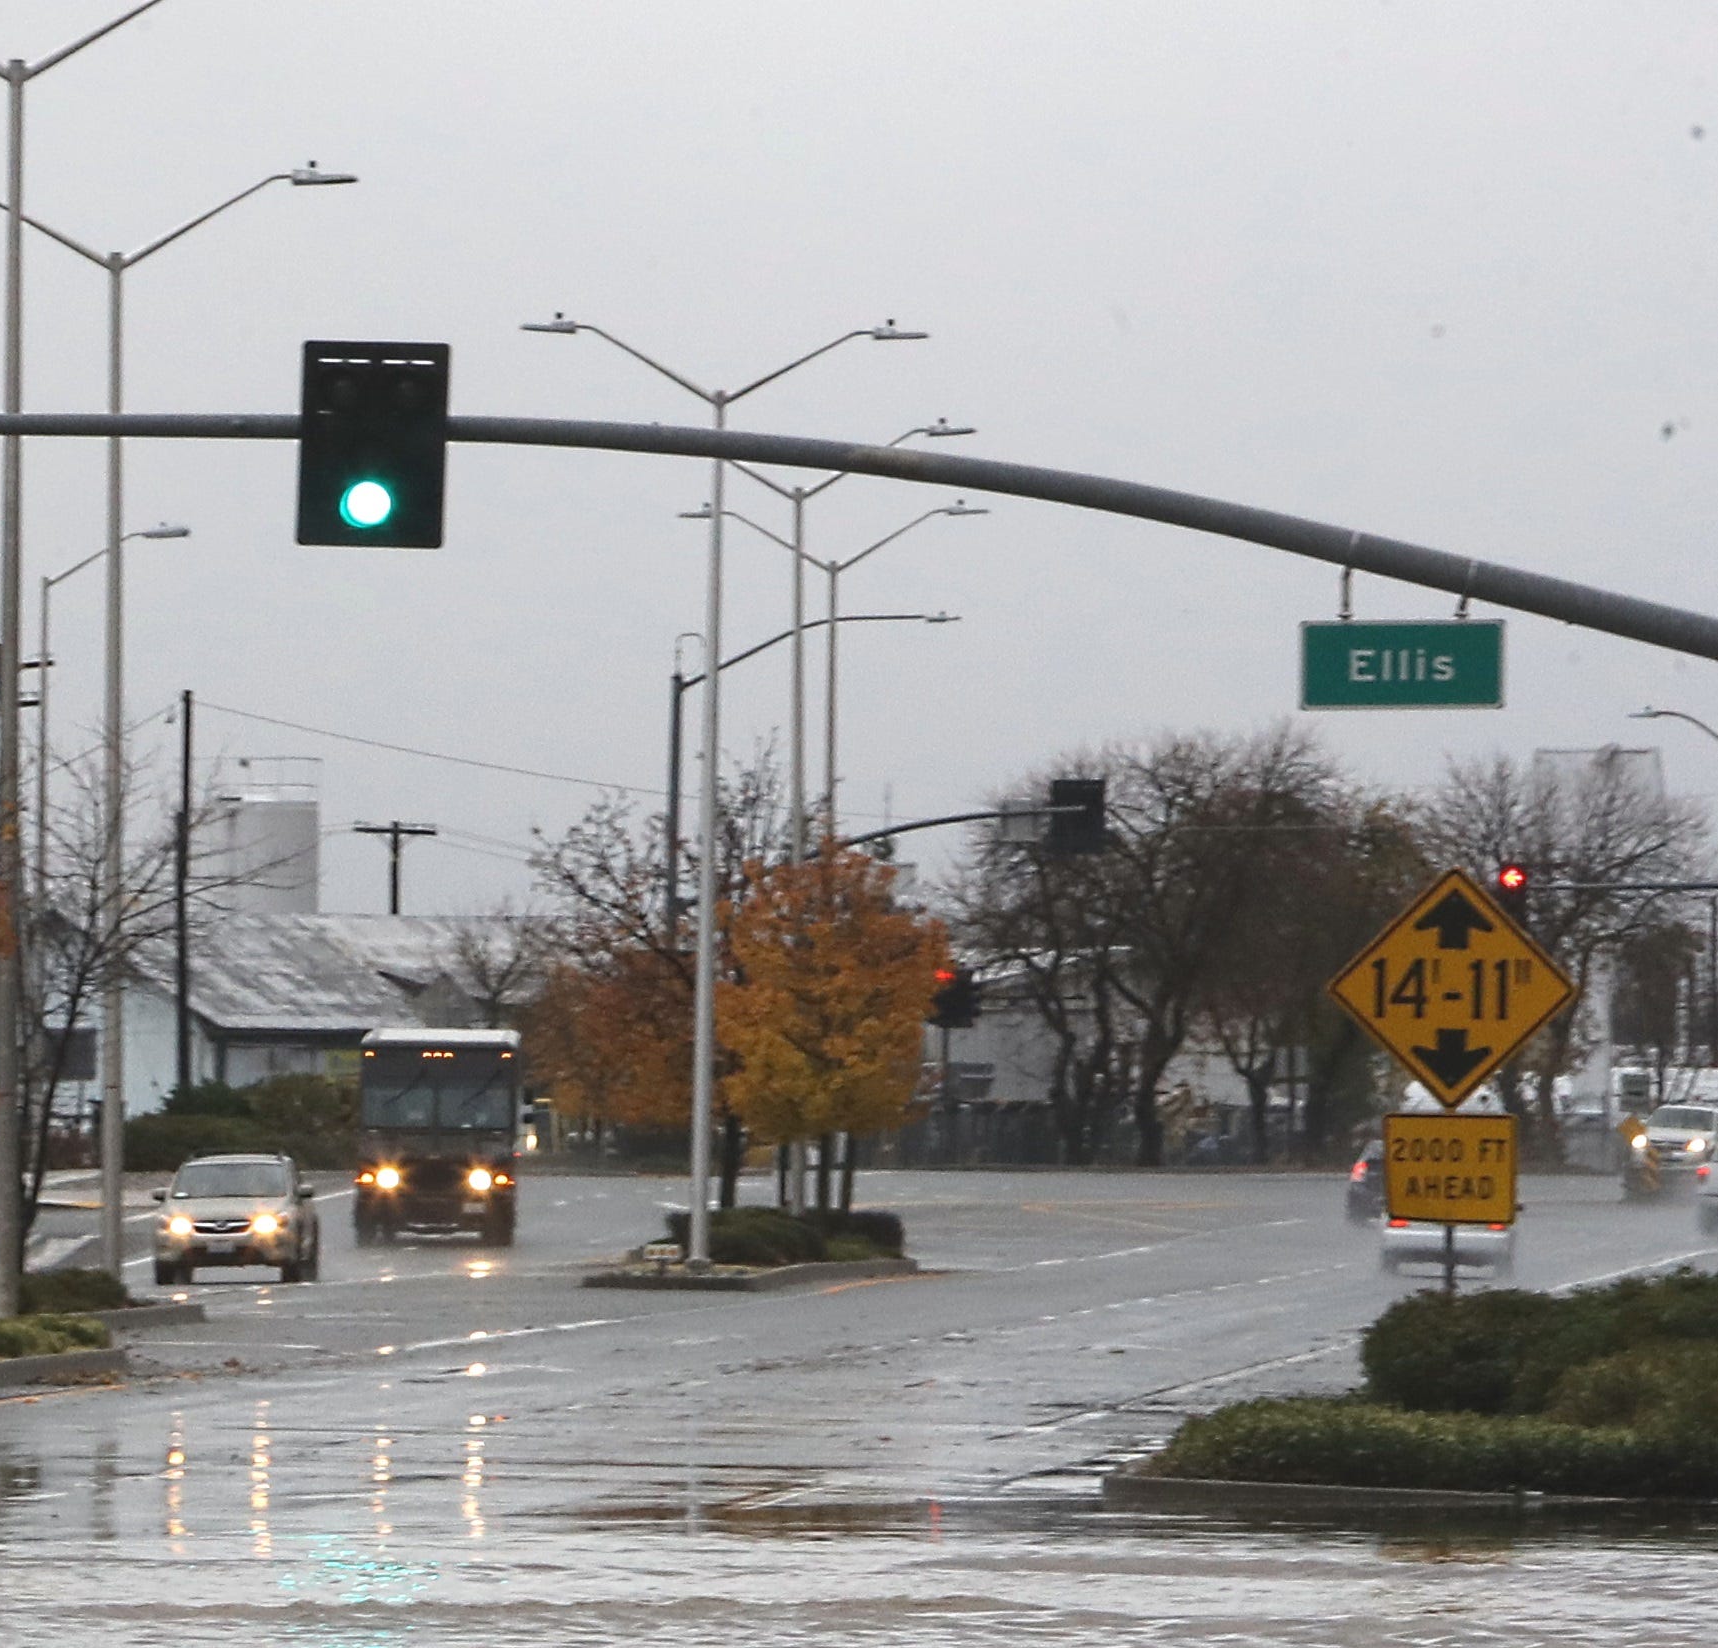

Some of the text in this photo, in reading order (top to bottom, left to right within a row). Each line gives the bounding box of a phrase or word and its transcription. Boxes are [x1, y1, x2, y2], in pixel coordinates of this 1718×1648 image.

[1349, 649, 1455, 681] Ellis
[1392, 1137, 1506, 1162] 2000 FT
[1405, 1175, 1496, 1200] AHEAD
